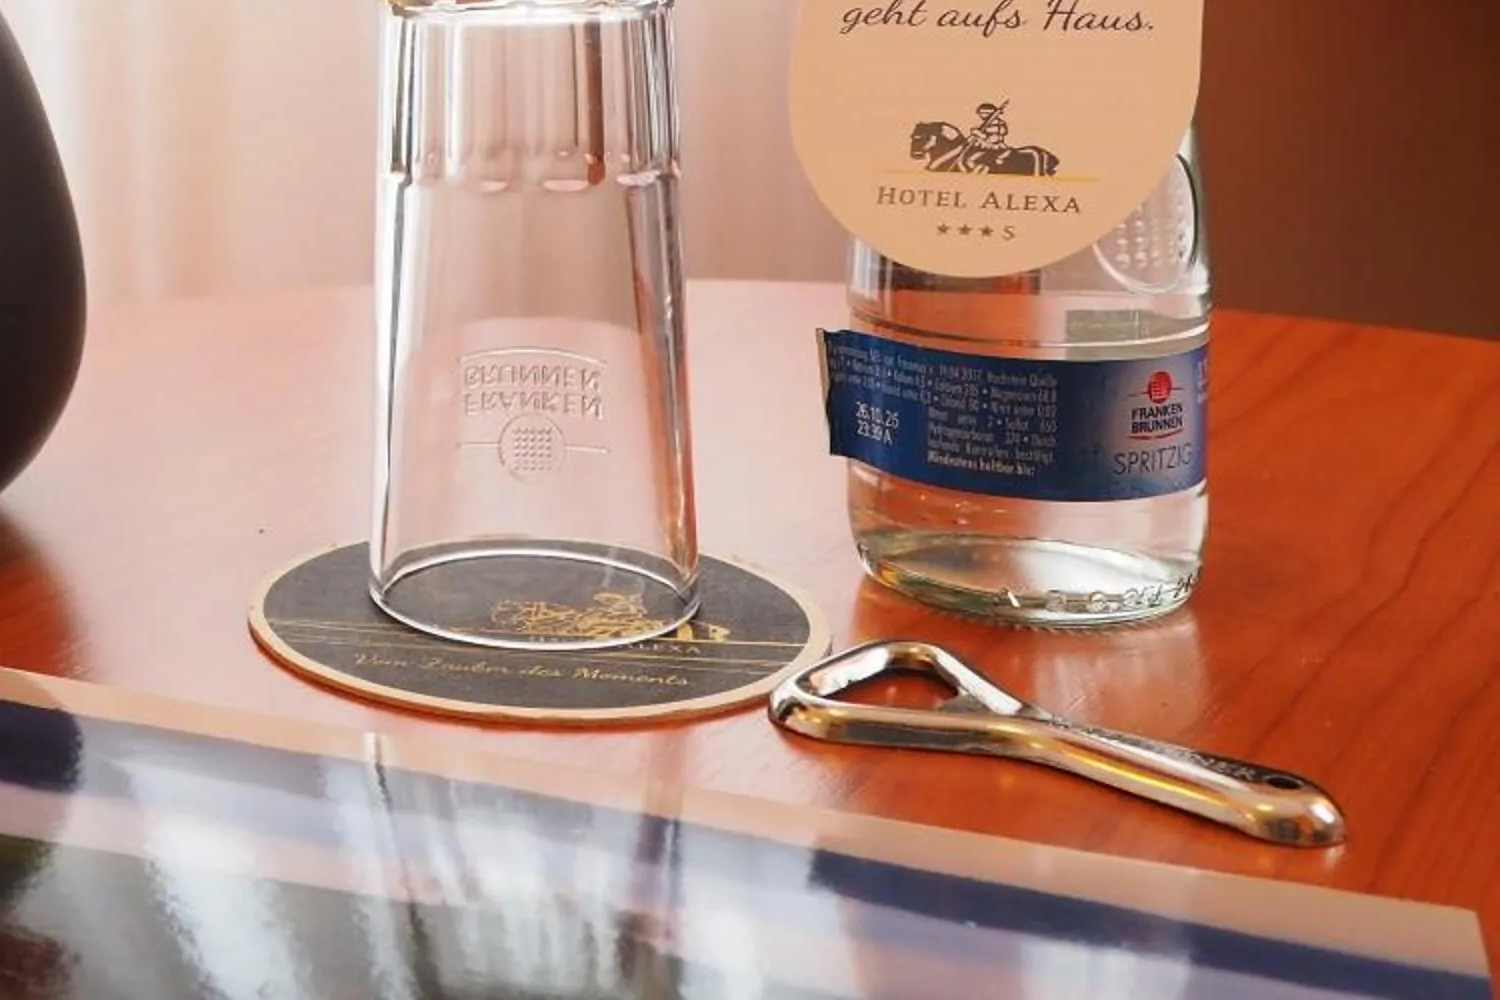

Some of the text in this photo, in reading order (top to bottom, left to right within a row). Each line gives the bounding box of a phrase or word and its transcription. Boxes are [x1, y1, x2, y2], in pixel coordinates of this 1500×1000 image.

[877, 185, 1082, 213] HOTEL ALEXA
[1131, 403, 1183, 420] FRANKEN
[1131, 416, 1183, 434] BRUNNEN
[1113, 441, 1192, 475] SPRITZIG
[573, 666, 690, 686] Moments
